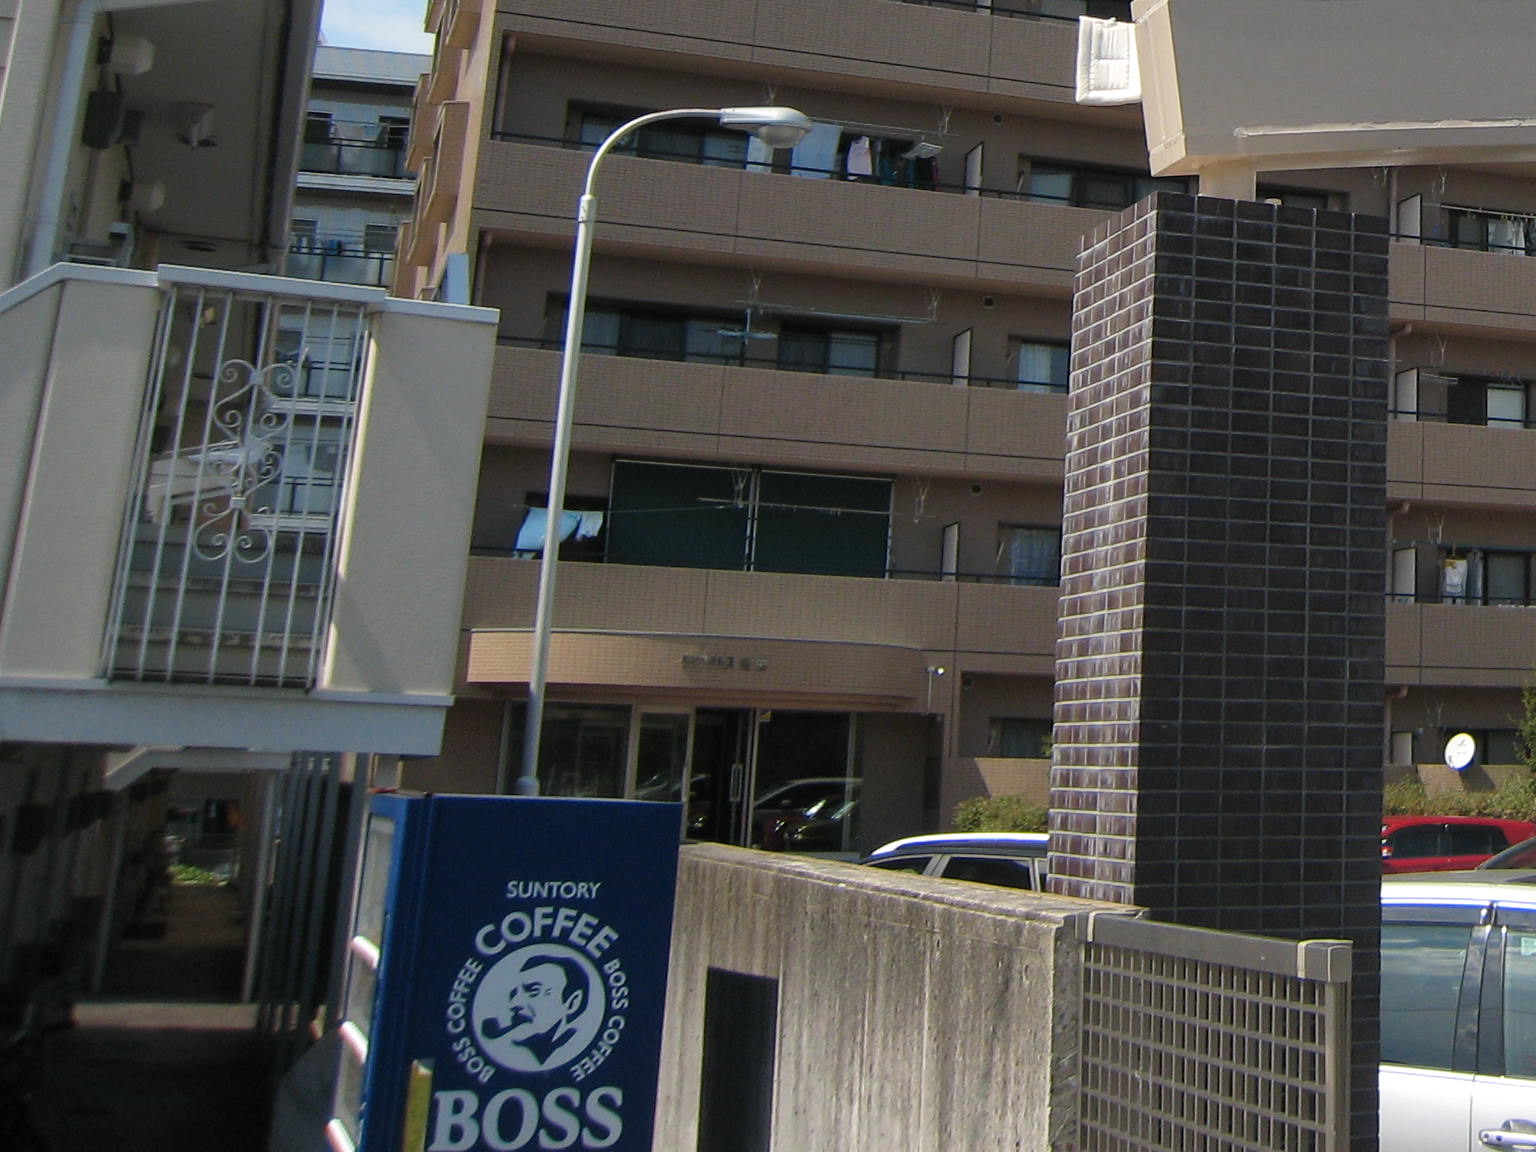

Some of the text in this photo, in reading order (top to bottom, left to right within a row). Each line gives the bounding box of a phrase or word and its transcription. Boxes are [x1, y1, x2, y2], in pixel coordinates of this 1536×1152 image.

[506, 880, 601, 899] SUNTORY
[475, 907, 619, 958] COFFEE
[447, 958, 497, 1085] BOSS COFFEE
[570, 958, 629, 1082] BOSS COFFEE
[428, 1087, 623, 1151] BOSS
